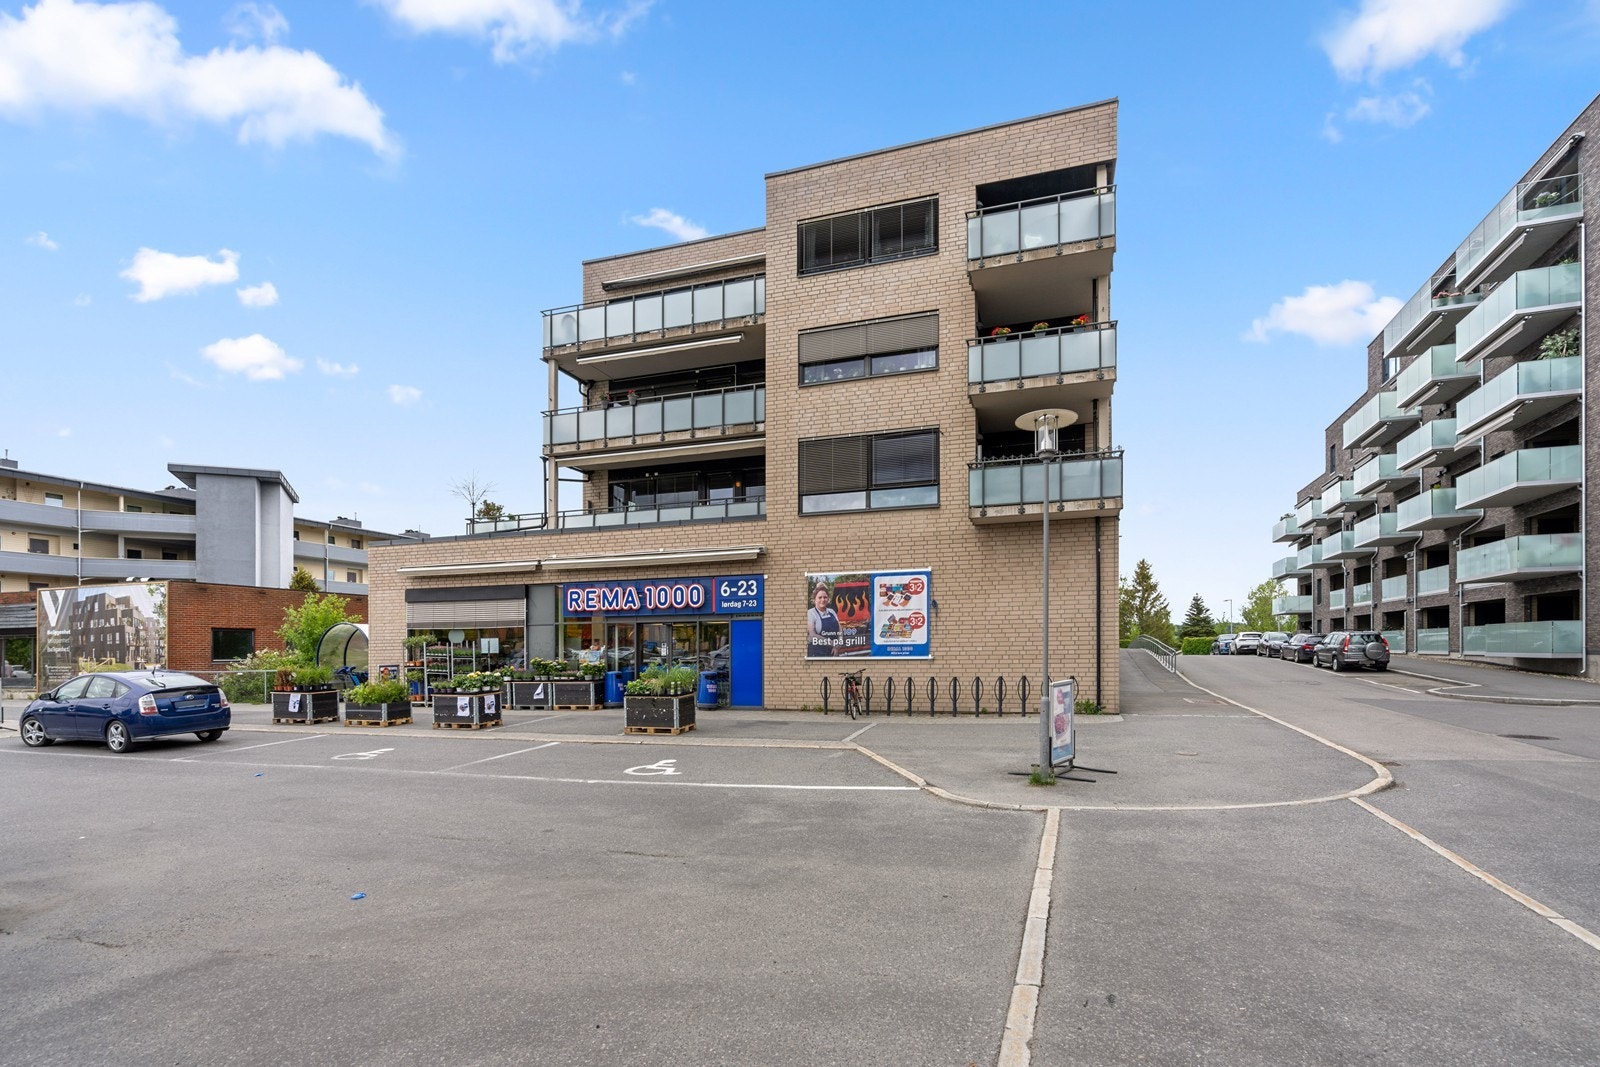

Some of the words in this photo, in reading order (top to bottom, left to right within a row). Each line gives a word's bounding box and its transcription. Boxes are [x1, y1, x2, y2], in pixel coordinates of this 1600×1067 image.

[720, 580, 757, 596] 6-23
[567, 587, 641, 611] REMA
[644, 584, 704, 609] 1000
[721, 600, 742, 608] lørdag
[41, 591, 65, 627] V
[812, 637, 832, 646] Best
[833, 636, 844, 647] på
[846, 636, 866, 647] grill!
